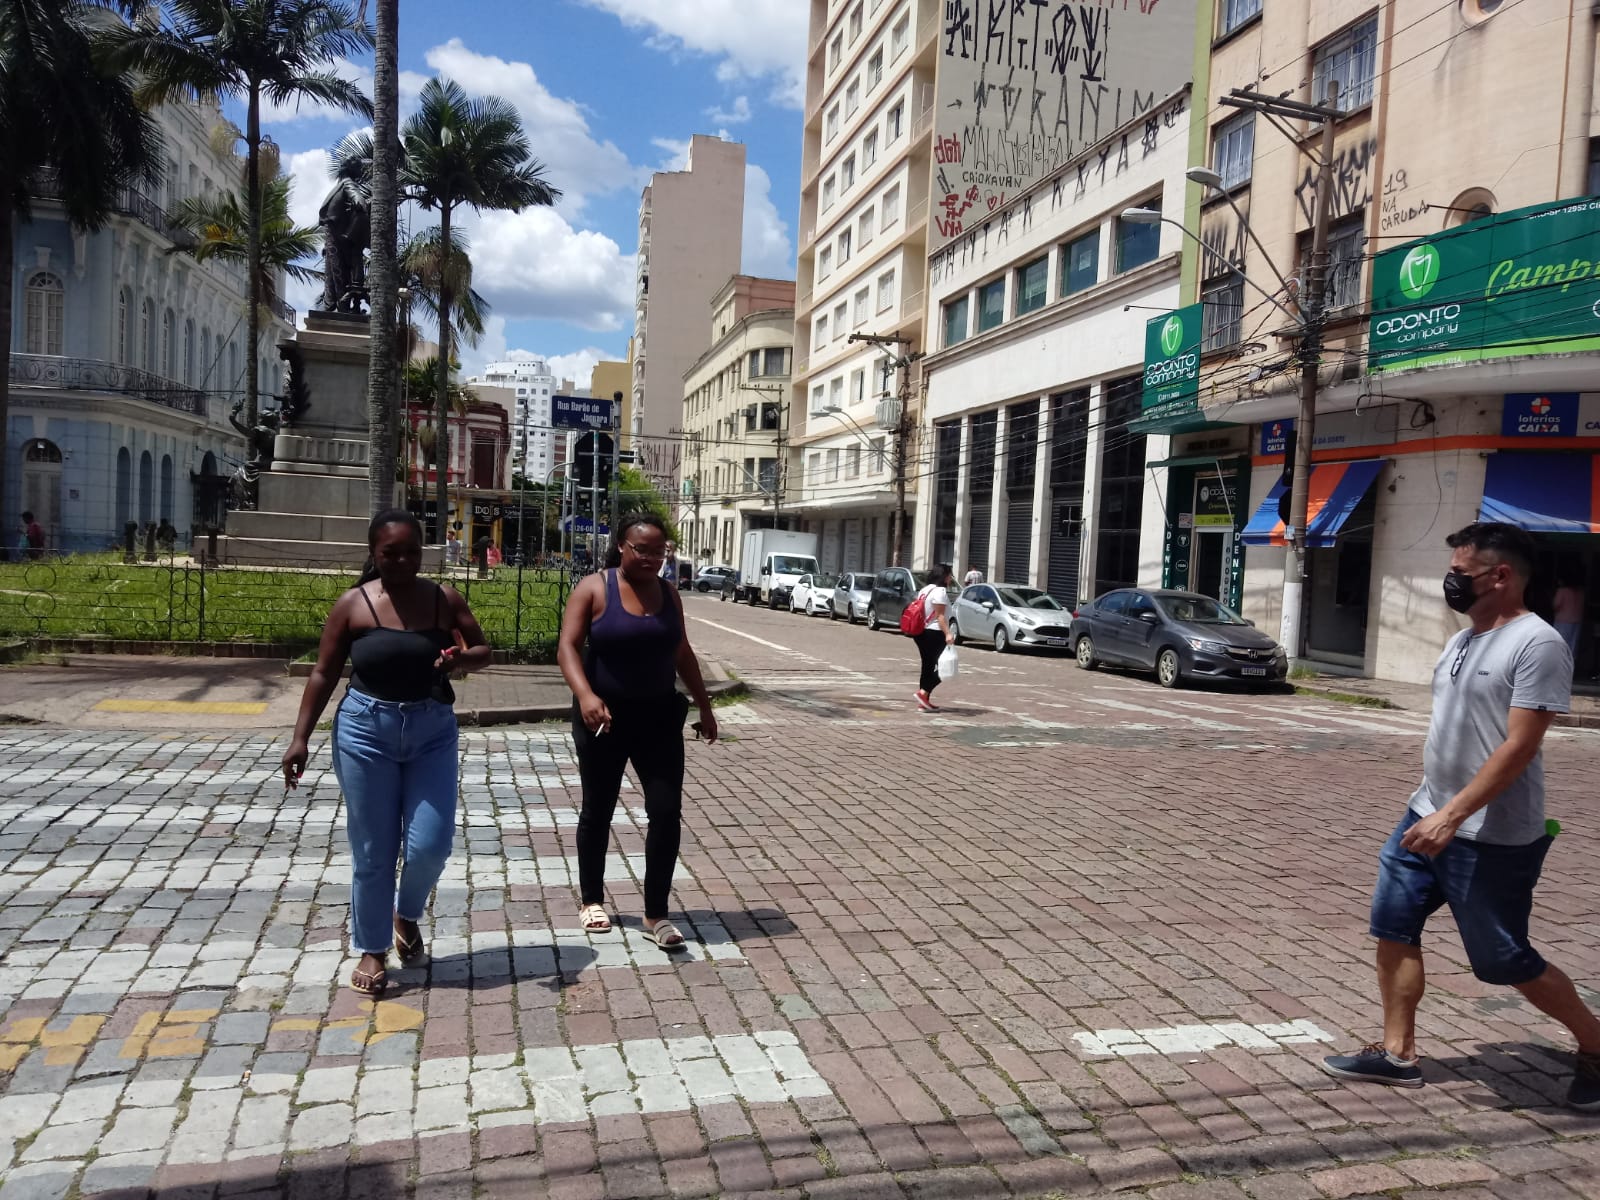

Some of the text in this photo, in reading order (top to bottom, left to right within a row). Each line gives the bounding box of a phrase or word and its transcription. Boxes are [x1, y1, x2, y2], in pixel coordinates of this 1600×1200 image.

[1383, 168, 1408, 195] 19
[1382, 196, 1397, 213] NA
[1376, 304, 1461, 336] ODONTO
[1397, 322, 1459, 343] company
[1146, 353, 1196, 376] ODONTO
[1145, 365, 1196, 386] company
[557, 400, 570, 411] Rua
[591, 404, 600, 413] de
[1518, 414, 1561, 423] loterias
[1518, 424, 1560, 433] CAIXA
